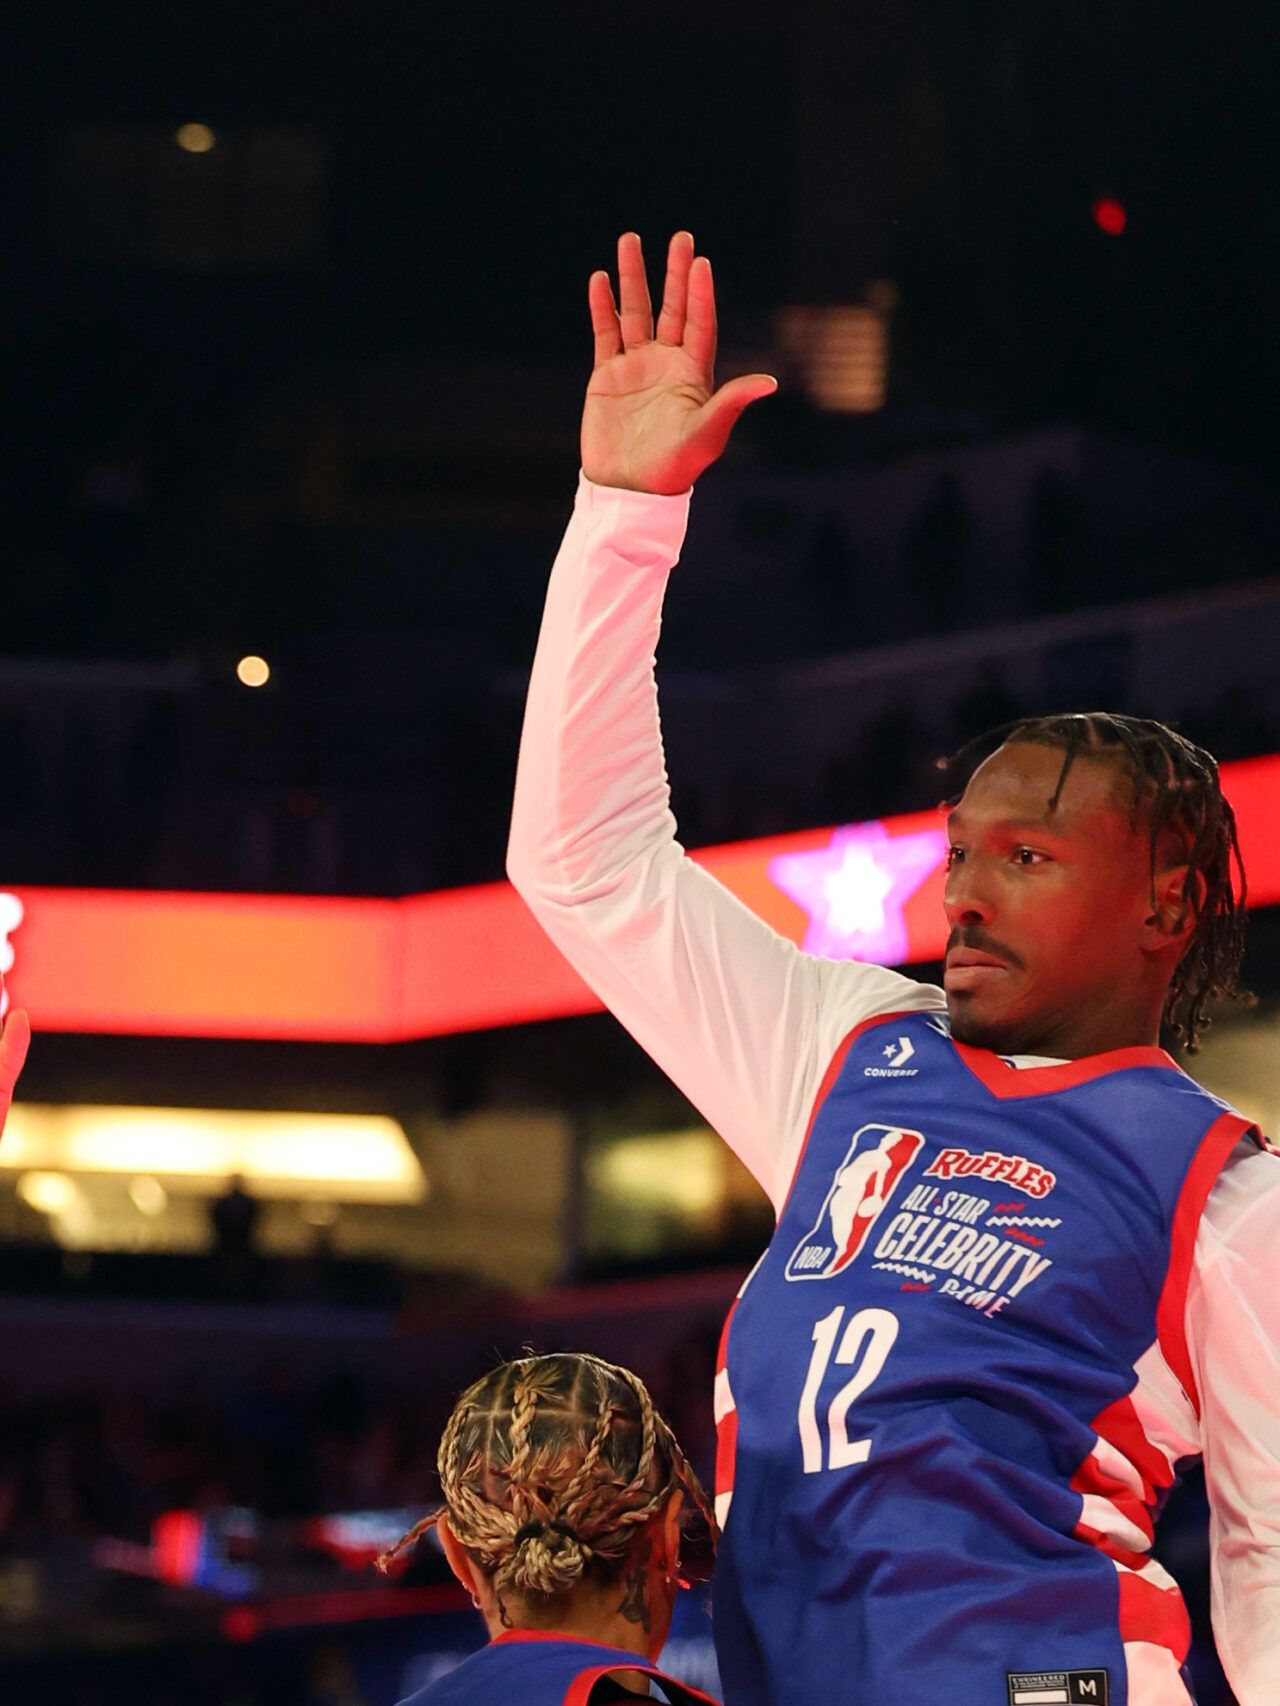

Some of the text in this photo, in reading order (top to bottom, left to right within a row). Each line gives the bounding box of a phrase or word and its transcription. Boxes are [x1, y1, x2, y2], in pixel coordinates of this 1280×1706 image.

[864, 1067, 919, 1077] CONVERSE
[923, 1149, 1056, 1199] RUFFLES
[793, 1246, 832, 1269] NBA
[873, 1212, 1054, 1298] CELEBRITY
[798, 1306, 899, 1474] 12
[1079, 1679, 1097, 1696] M
